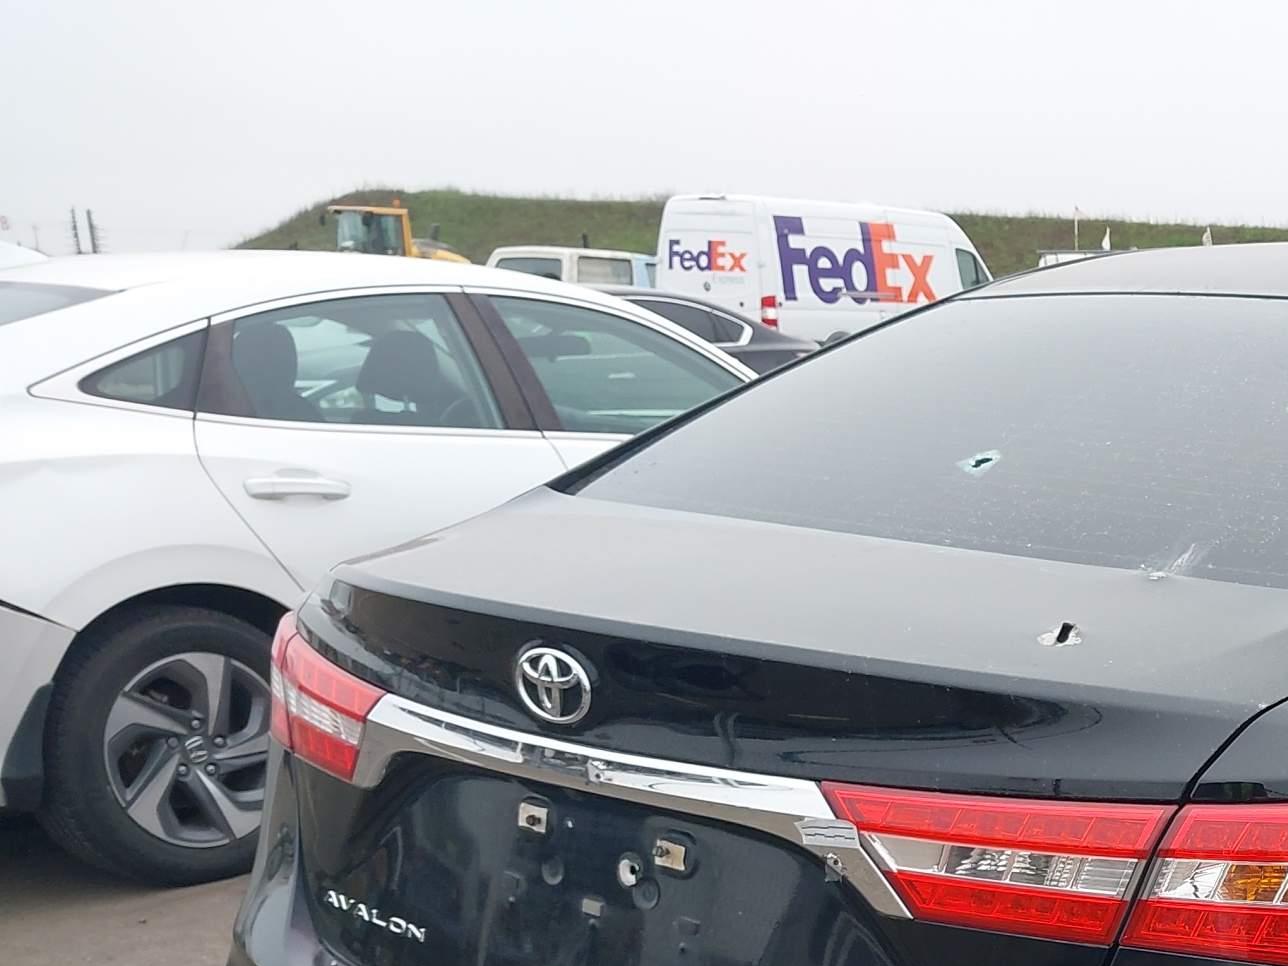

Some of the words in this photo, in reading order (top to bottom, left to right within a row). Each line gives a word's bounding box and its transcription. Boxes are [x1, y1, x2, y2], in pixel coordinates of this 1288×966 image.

[668, 239, 747, 272] FedEx
[773, 215, 937, 304] FedEx
[324, 890, 426, 942] AVALON
